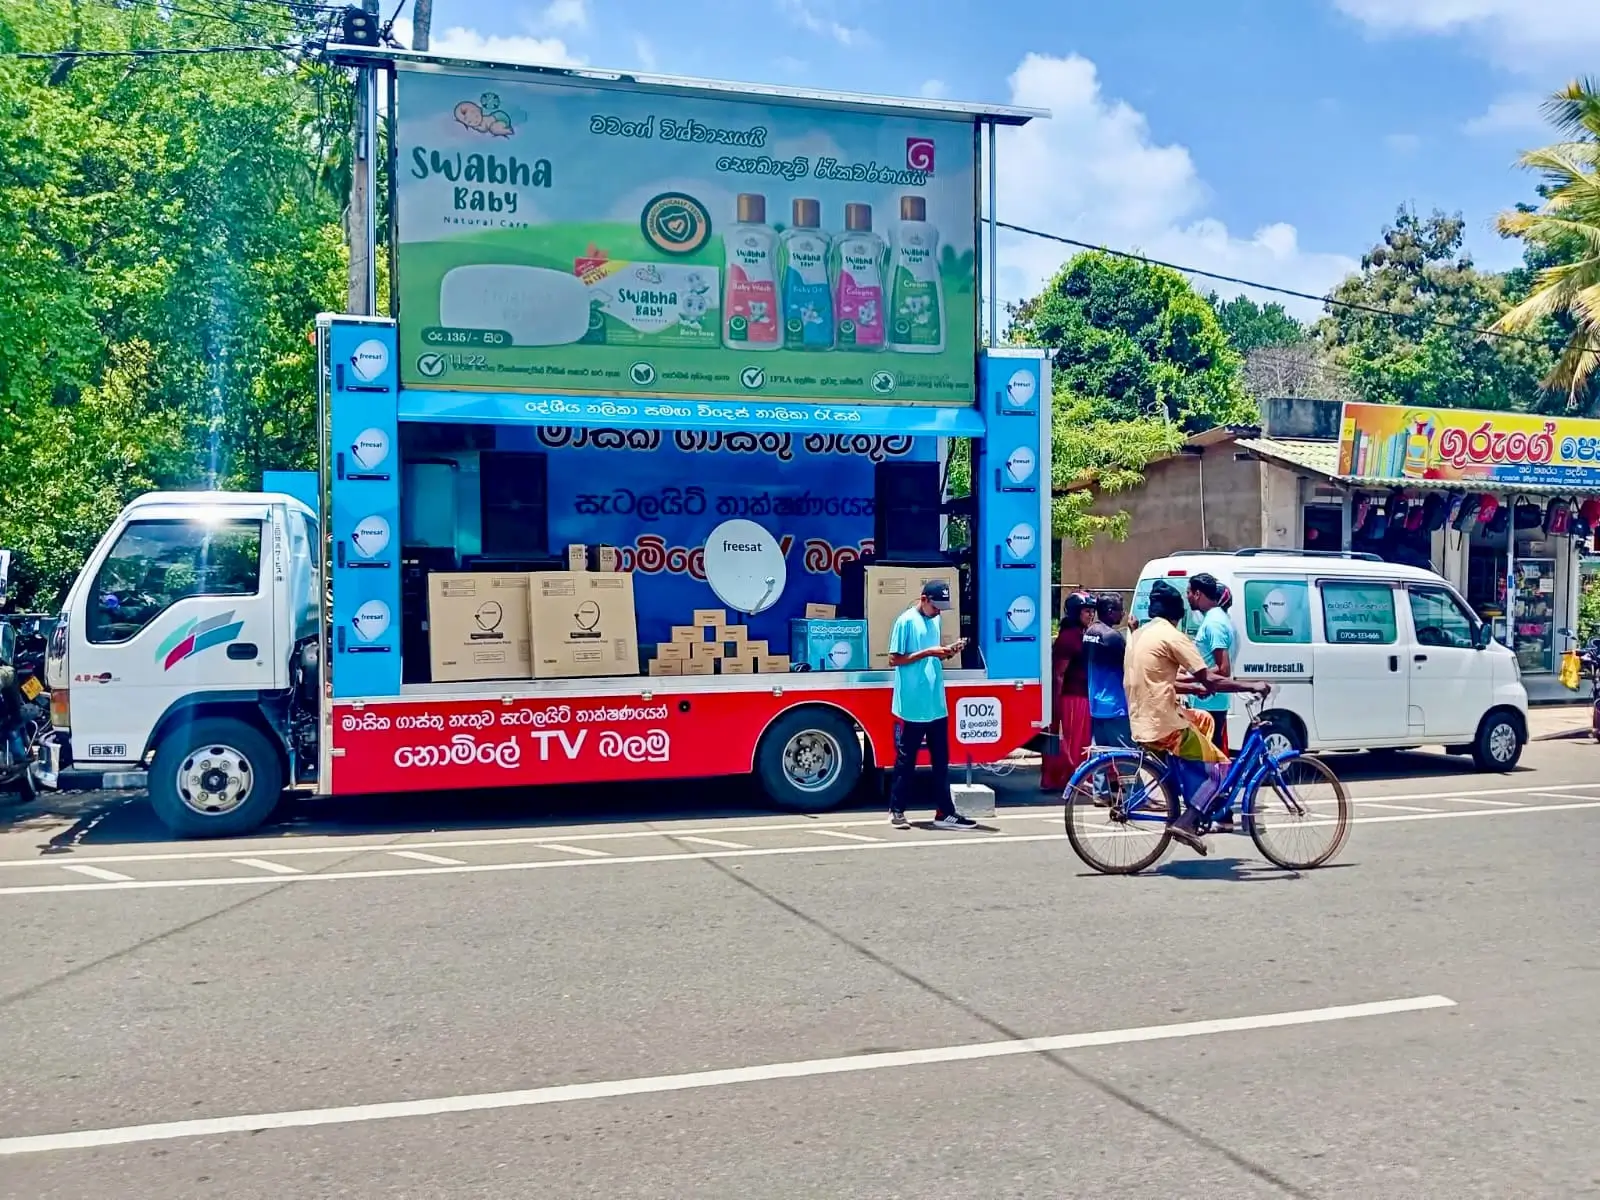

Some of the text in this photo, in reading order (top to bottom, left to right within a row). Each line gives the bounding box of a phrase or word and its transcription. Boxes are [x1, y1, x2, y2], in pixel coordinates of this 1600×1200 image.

[590, 115, 655, 139] මවගේ
[411, 146, 552, 188] Swabha
[443, 215, 529, 229] Natural Care
[359, 352, 382, 360] freesat
[525, 400, 580, 415] දේශීය
[697, 404, 750, 420] විදෙස්
[755, 407, 809, 421] නාලිකා
[1439, 421, 1557, 469] ගුරුගේ
[722, 539, 763, 553] freesat
[1357, 613, 1369, 623] TV
[1243, 662, 1304, 673] www.freesat.lk
[342, 703, 668, 731] මාසික ගාස්තු නැතුව සැටලයිට් තාක්ෂණයෙන්
[963, 703, 995, 717] 100%
[91, 745, 125, 756] 自家用
[394, 728, 670, 768] නොමිලේ TV බලමු
